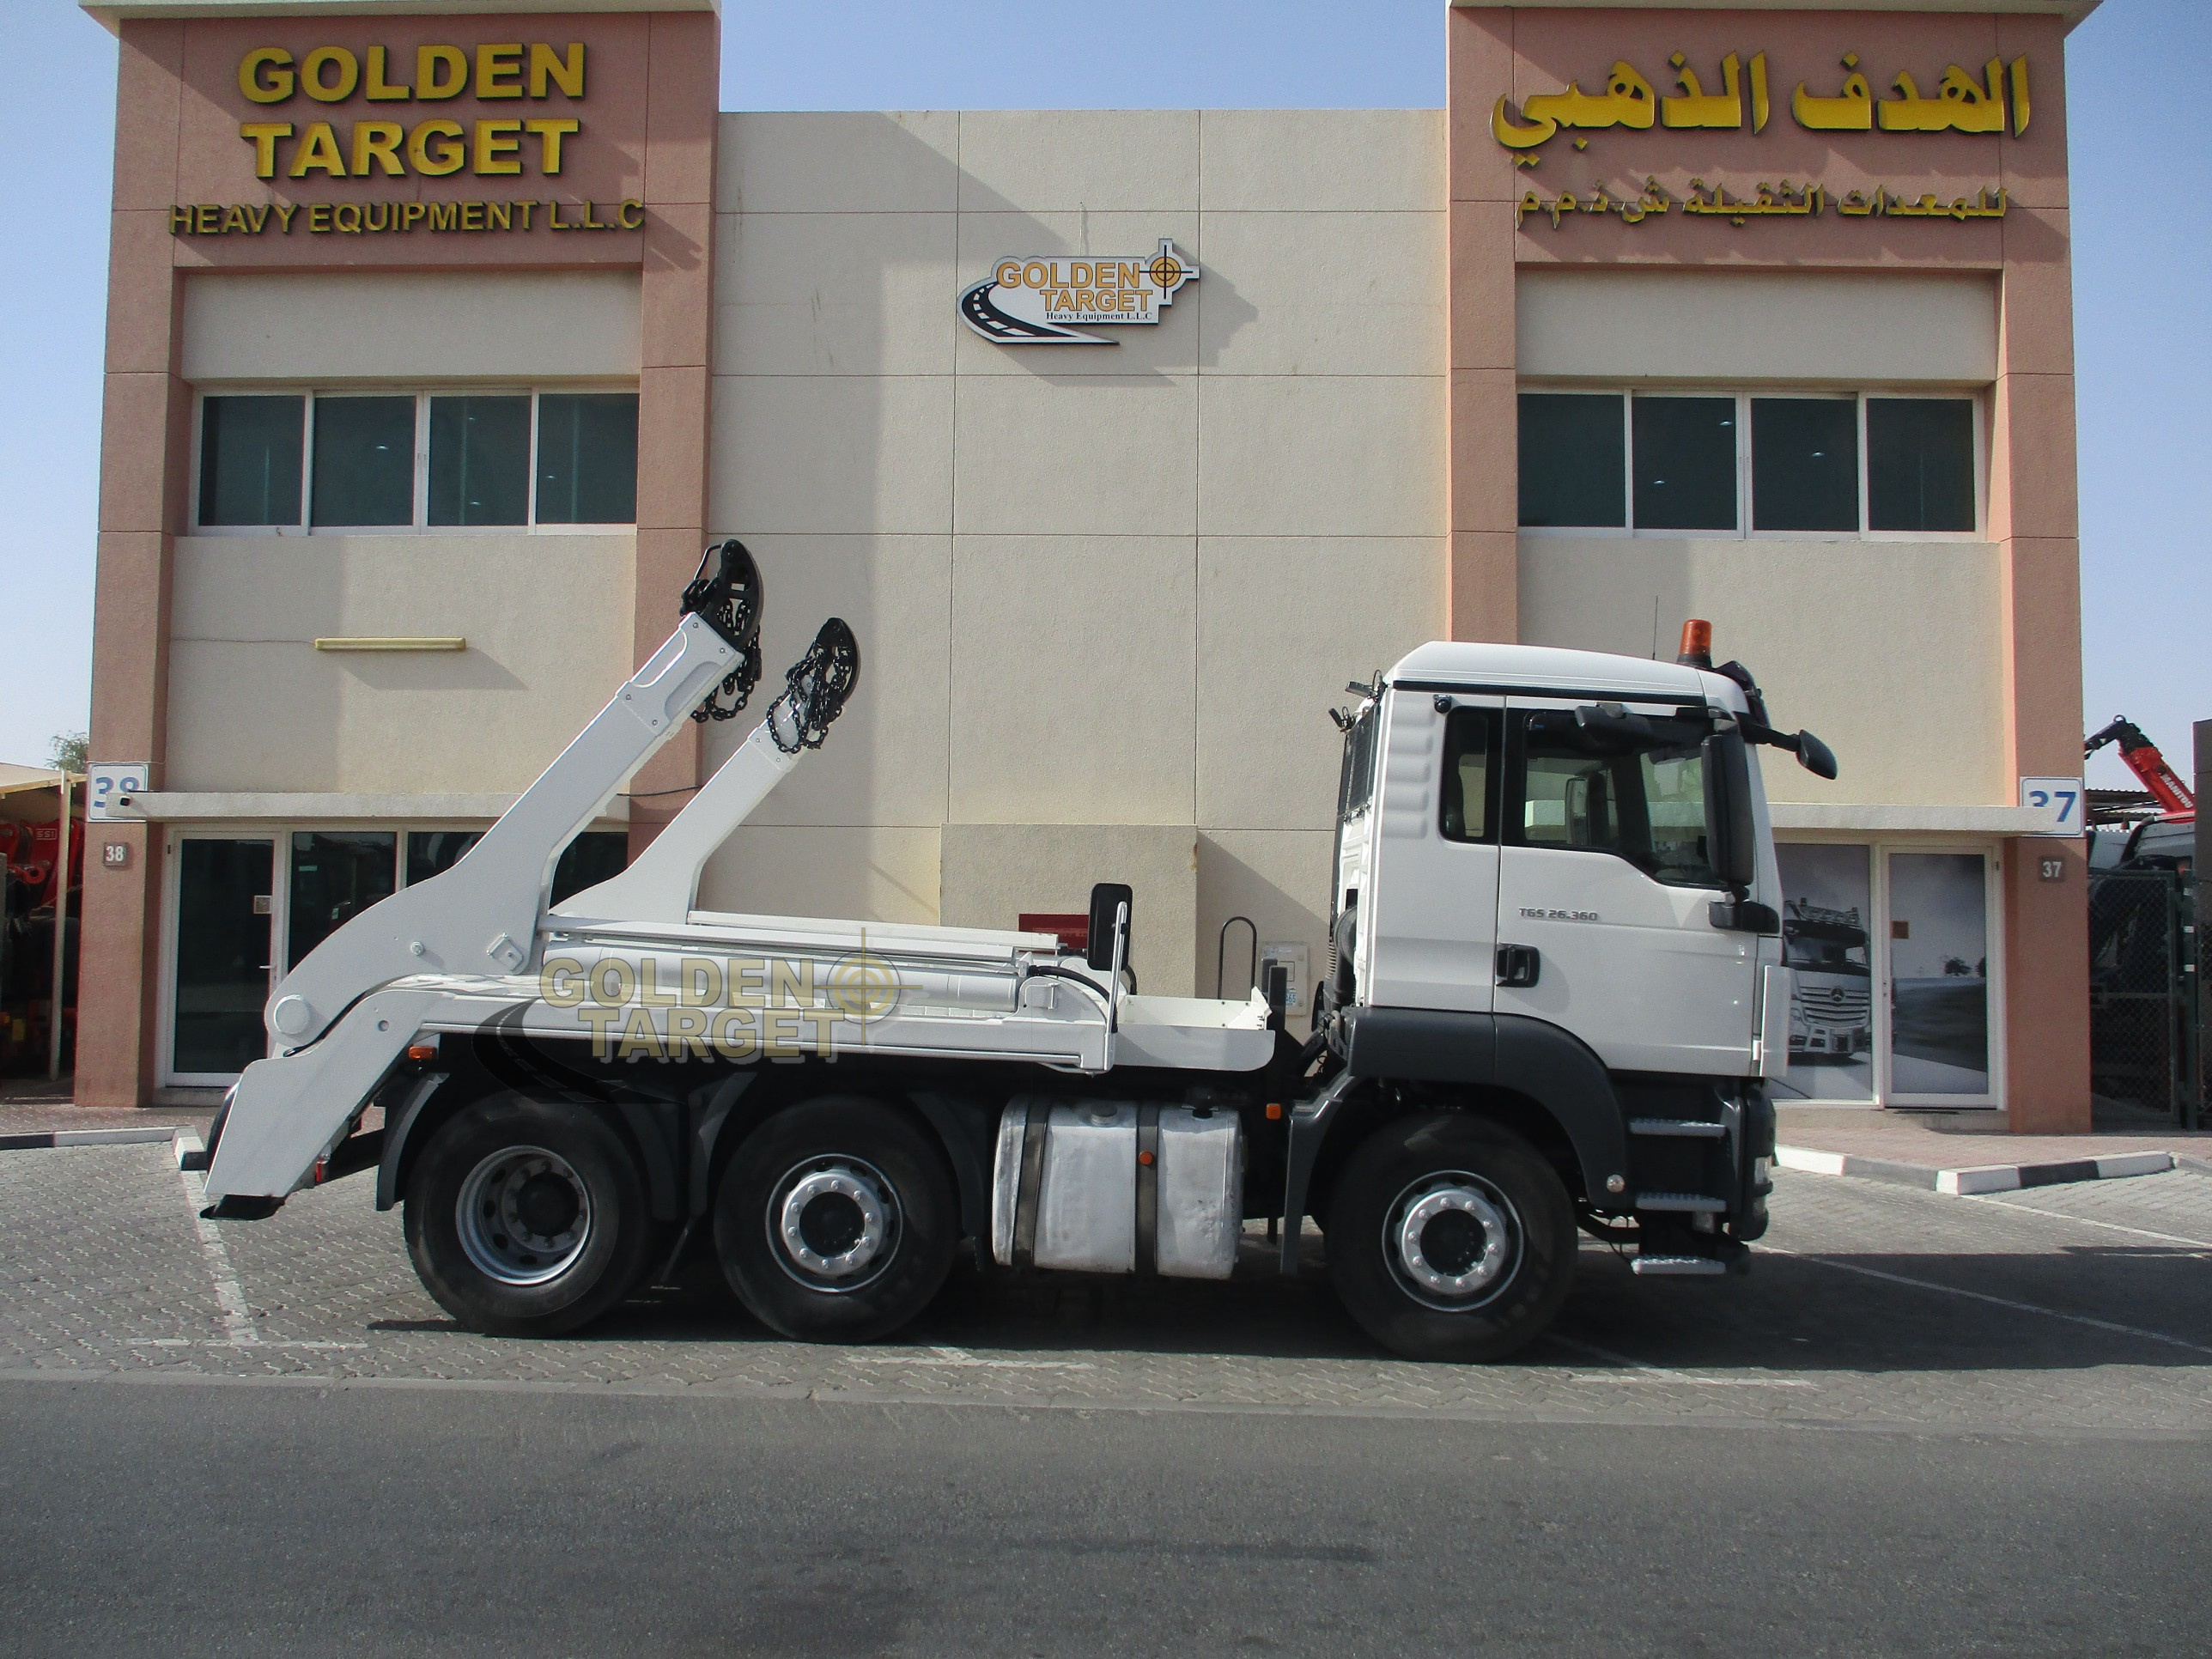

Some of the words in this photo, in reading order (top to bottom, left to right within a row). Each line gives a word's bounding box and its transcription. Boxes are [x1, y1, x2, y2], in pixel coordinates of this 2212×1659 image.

[238, 43, 586, 104] GOLDEN
[1489, 49, 1769, 167] الذهبي
[1791, 52, 2030, 137] الهدف
[239, 118, 580, 179] TARGET
[168, 203, 301, 234] HEAVY
[308, 199, 538, 234] EQUIPMENT
[548, 198, 646, 231] L.L.C
[1682, 178, 1825, 228] الثقيلة
[1838, 184, 2008, 220] للمعدات
[996, 261, 1140, 289] GOLDEN
[1039, 289, 1153, 312] TARGET
[1046, 312, 1073, 321] Heavy
[1076, 312, 1124, 321] Equipment
[1127, 312, 1152, 320] L.L.C
[2160, 774, 2193, 808] MANITOU
[106, 845, 125, 862] 38
[2042, 861, 2062, 878] 37
[1519, 908, 1545, 918] TGS
[1548, 909, 1599, 921] 26.360
